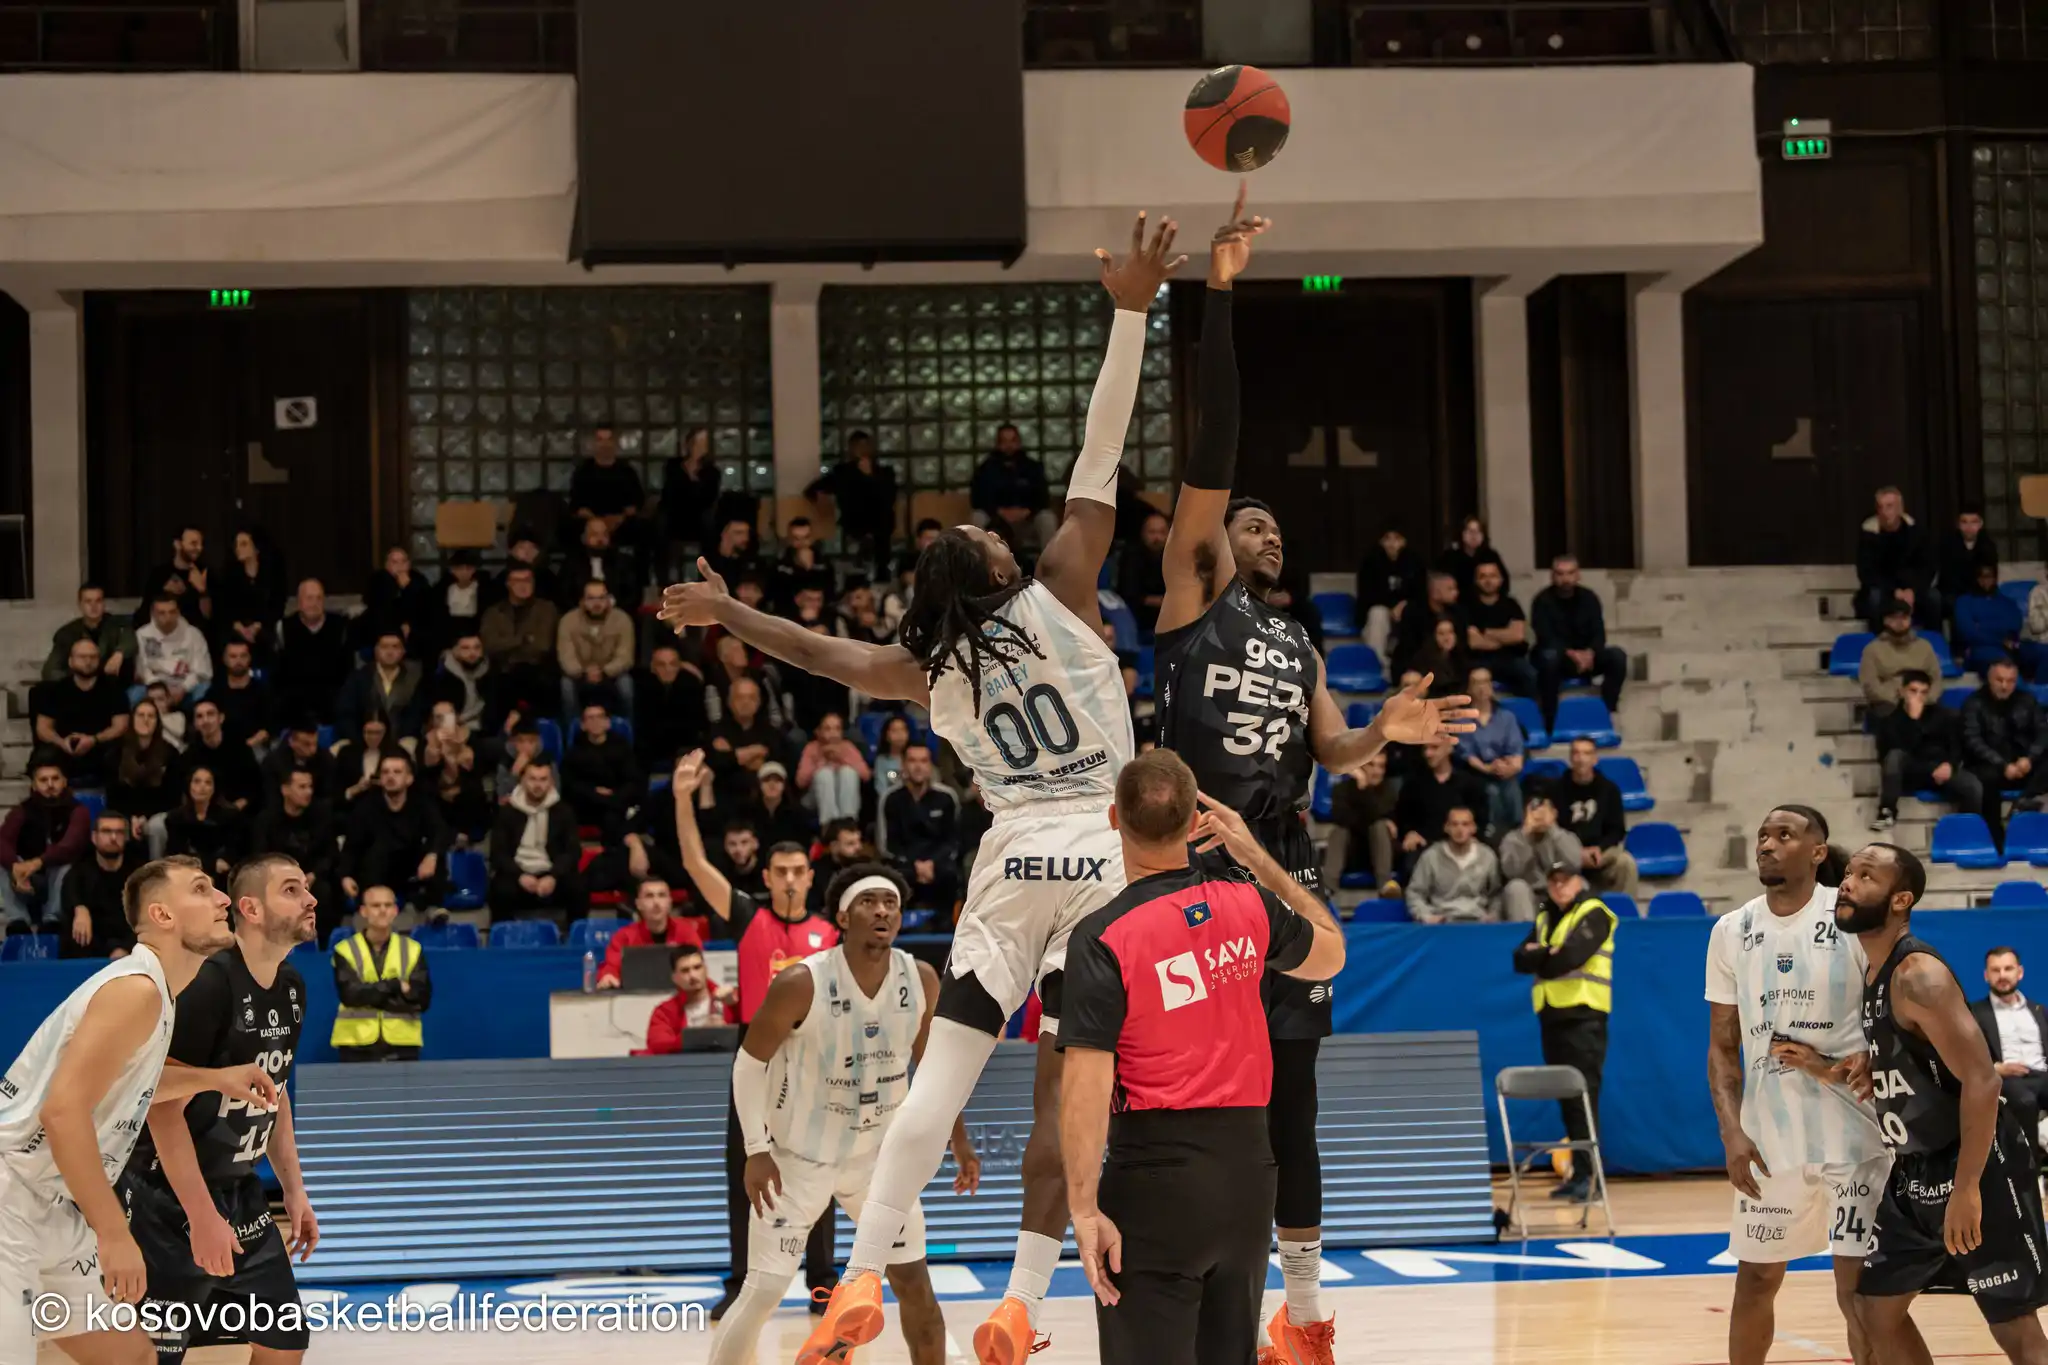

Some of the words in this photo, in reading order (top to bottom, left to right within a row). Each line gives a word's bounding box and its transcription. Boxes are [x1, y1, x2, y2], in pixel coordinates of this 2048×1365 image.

[1245, 637, 1303, 673] go+
[983, 683, 1080, 770] 00
[1223, 711, 1291, 762] 32
[1049, 750, 1108, 777] NEPTUN
[1814, 921, 1839, 945] 24
[1204, 936, 1257, 971] SAVA
[1210, 960, 1257, 981] NSURNCE
[899, 986, 909, 1008] 2
[1782, 988, 1815, 1000] HOME
[260, 1026, 291, 1038] KASTRATI
[1788, 1020, 1834, 1030] AIRKOND
[1872, 1069, 1916, 1100] JA
[232, 1120, 274, 1163] 11
[1833, 1206, 1867, 1243] 24
[1978, 1269, 2019, 1290] GOGAJ
